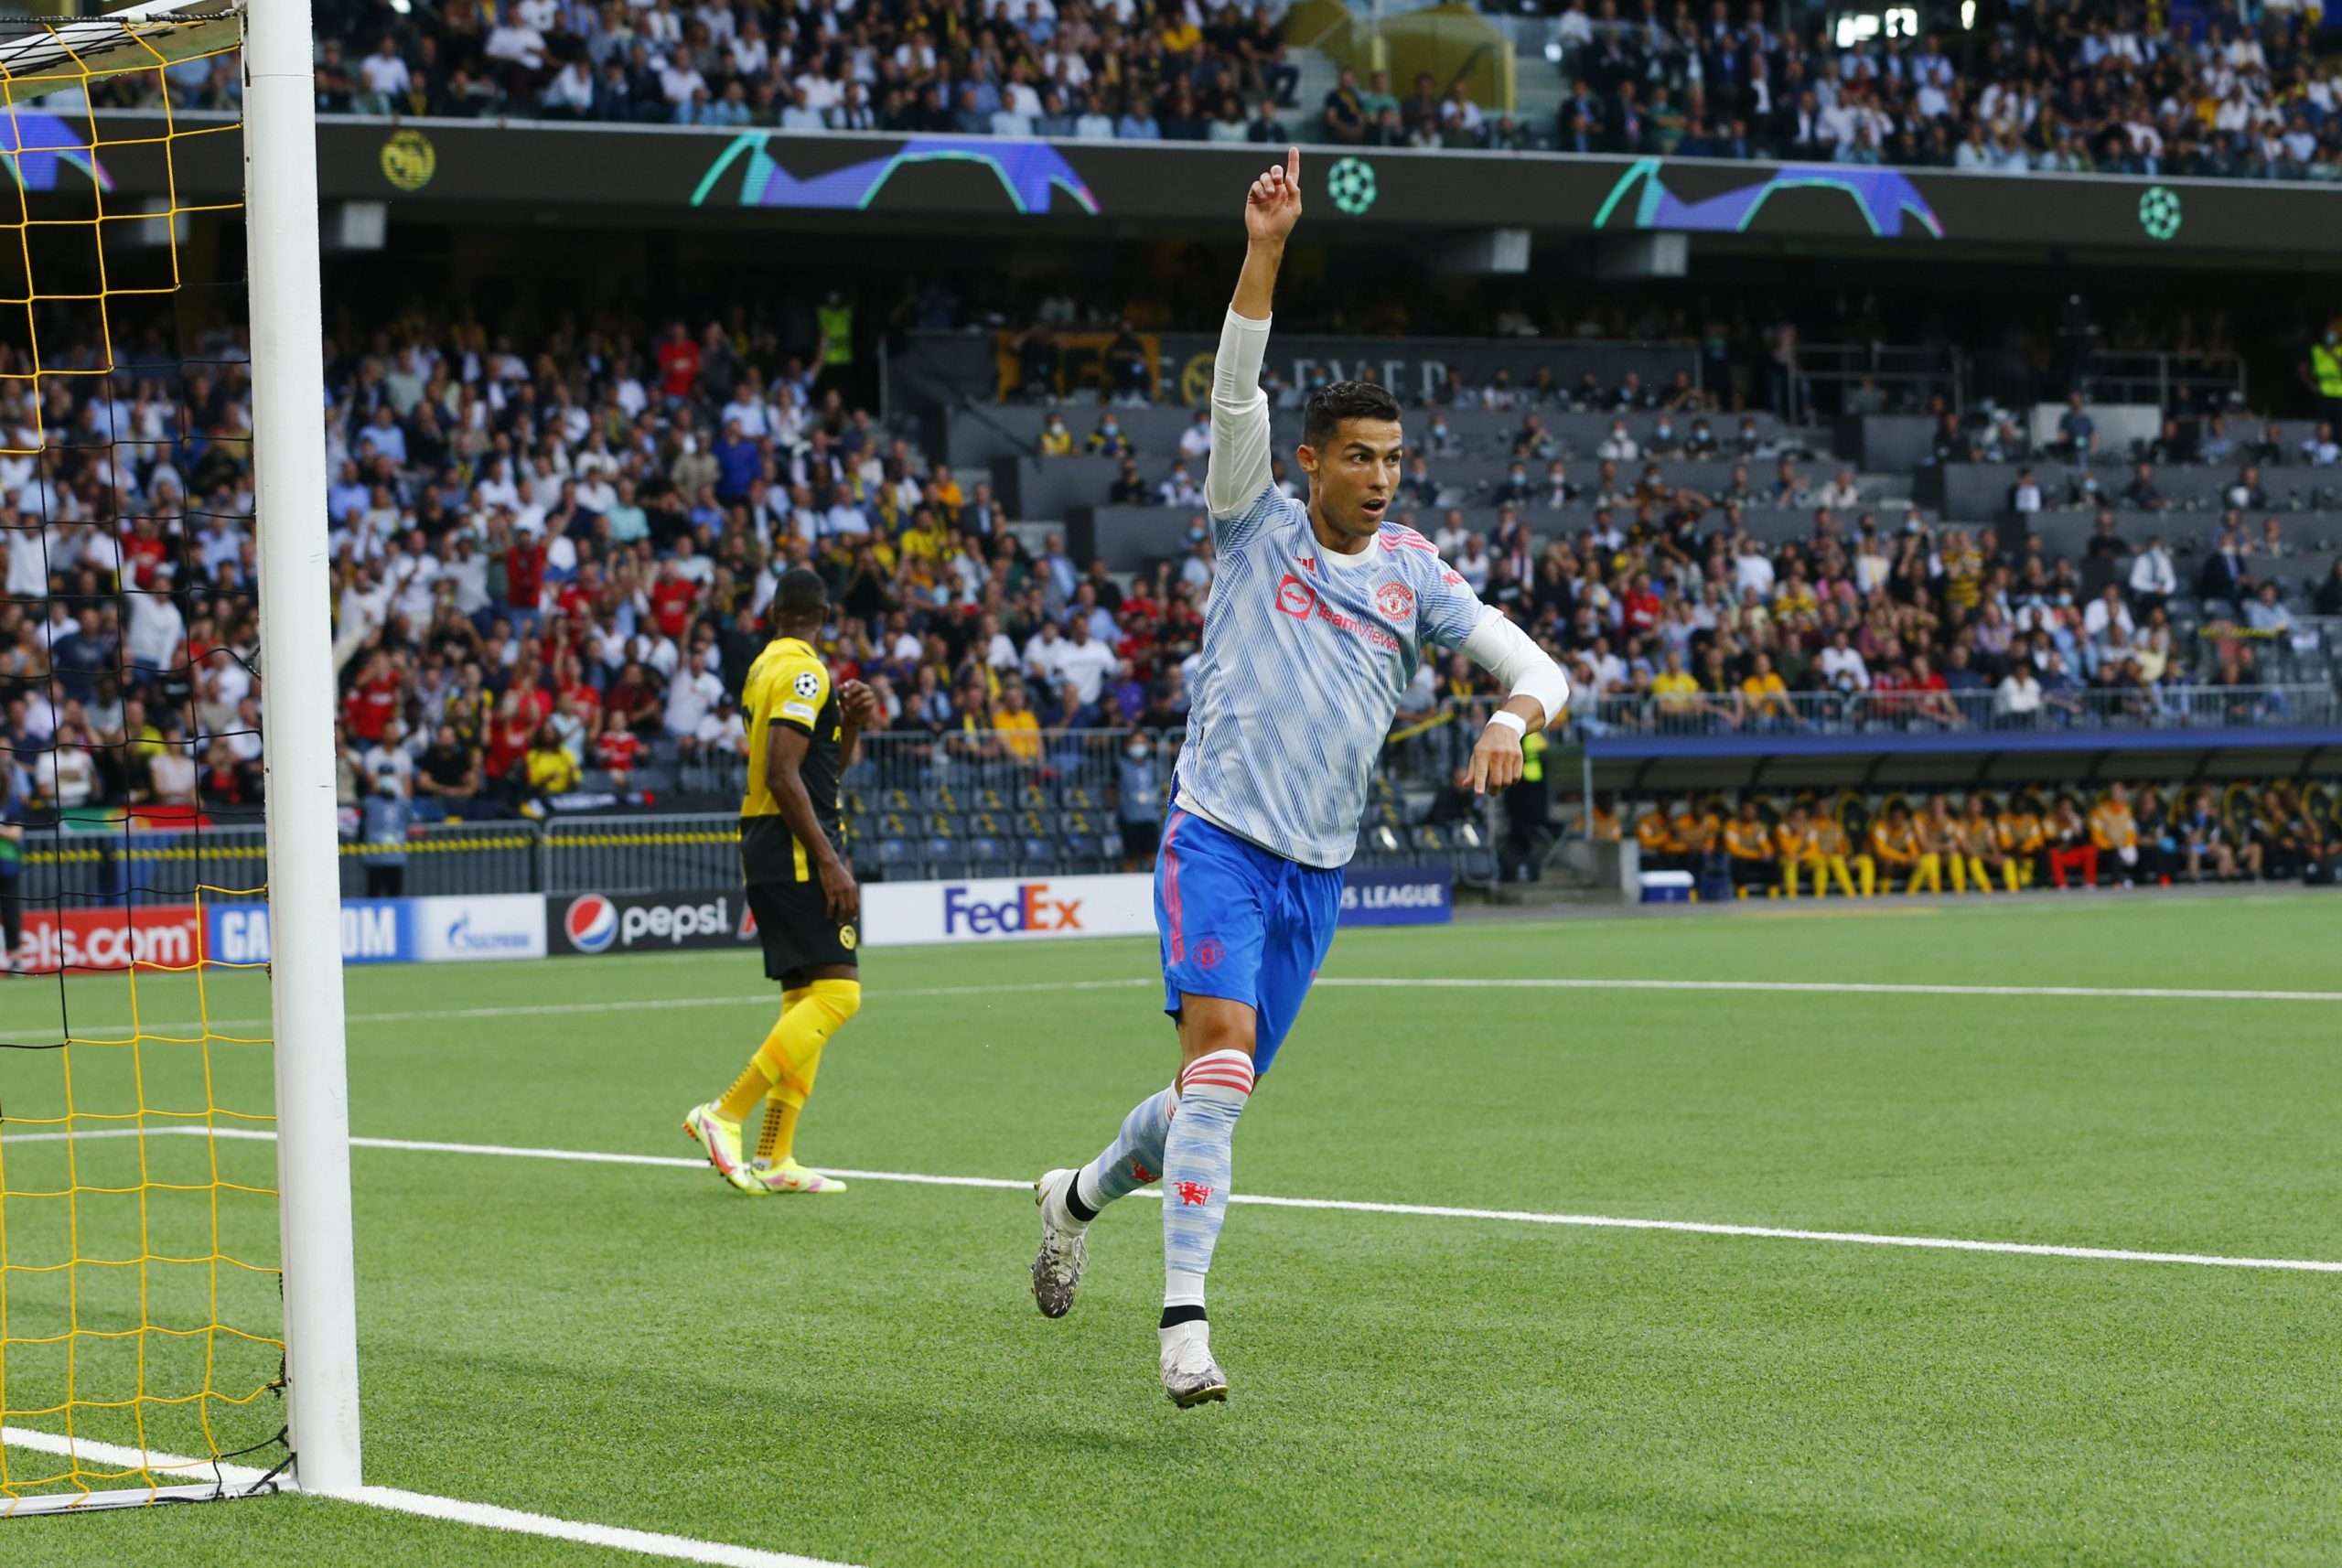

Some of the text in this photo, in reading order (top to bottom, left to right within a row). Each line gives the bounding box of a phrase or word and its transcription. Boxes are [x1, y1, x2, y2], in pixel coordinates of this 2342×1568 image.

[1316, 599, 1401, 654] TeamViewe
[622, 897, 728, 946] pepsi
[944, 883, 1084, 935] FedEx
[1362, 883, 1443, 908] LEAGUE
[220, 906, 397, 960] GAOM
